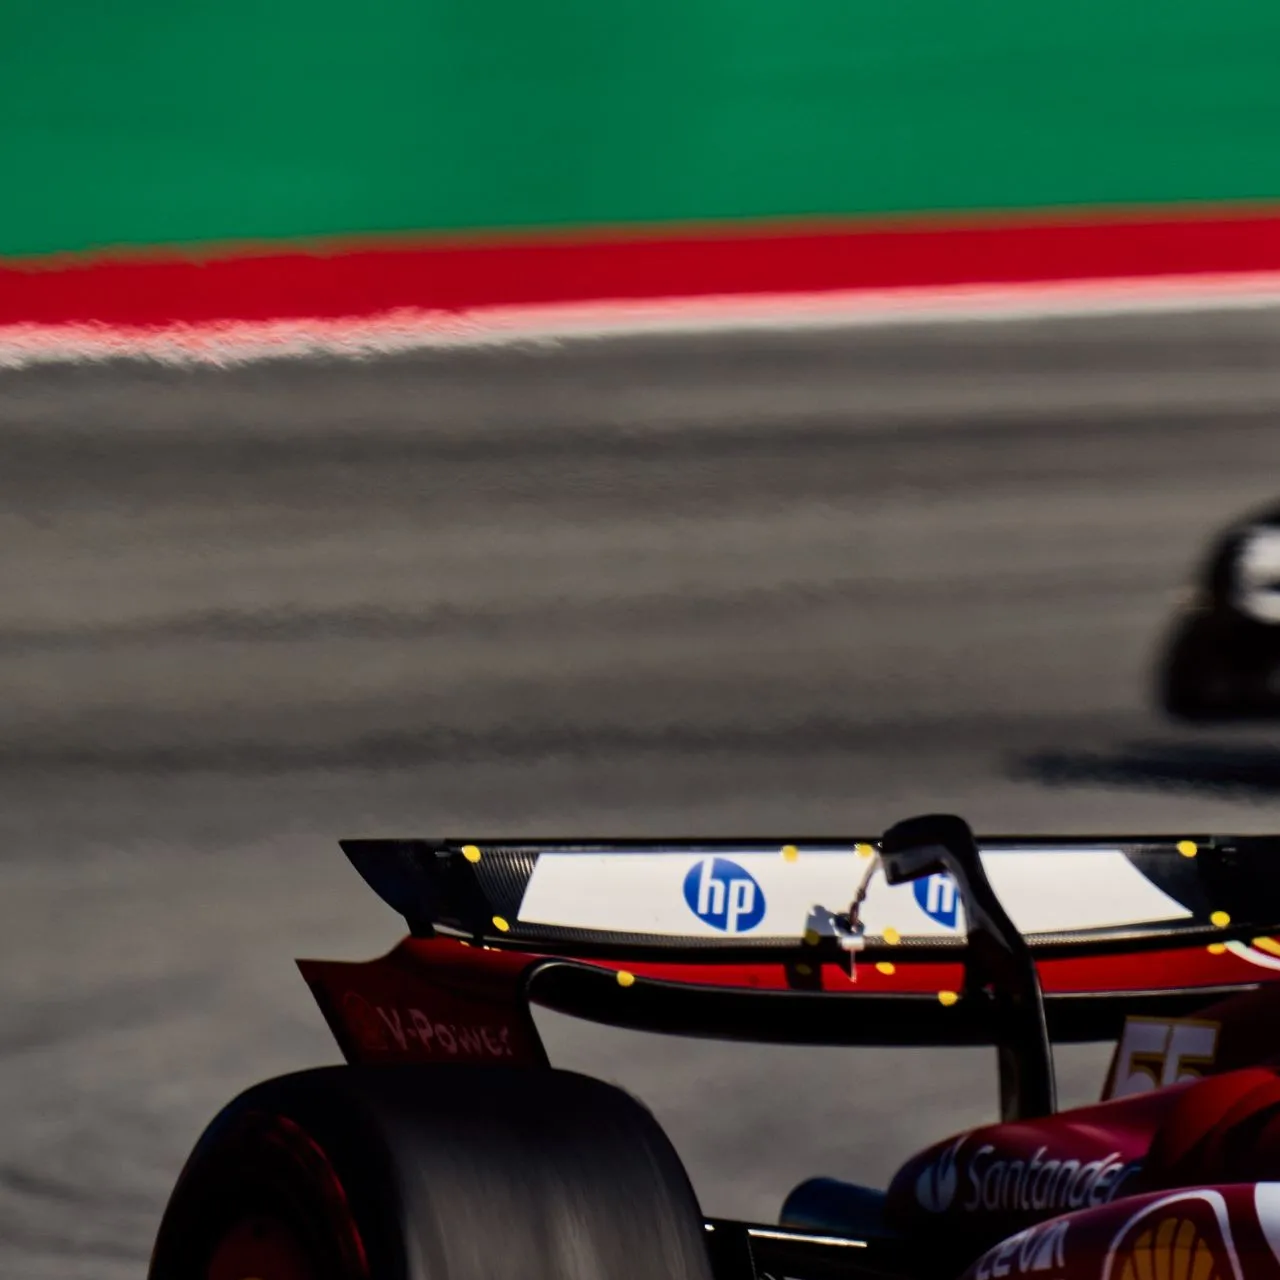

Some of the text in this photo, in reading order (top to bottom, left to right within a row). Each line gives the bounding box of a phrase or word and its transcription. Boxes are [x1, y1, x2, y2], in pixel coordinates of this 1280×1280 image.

[698, 858, 756, 932] hp
[375, 1005, 513, 1057] V-Power
[964, 1144, 1143, 1213] Santander
